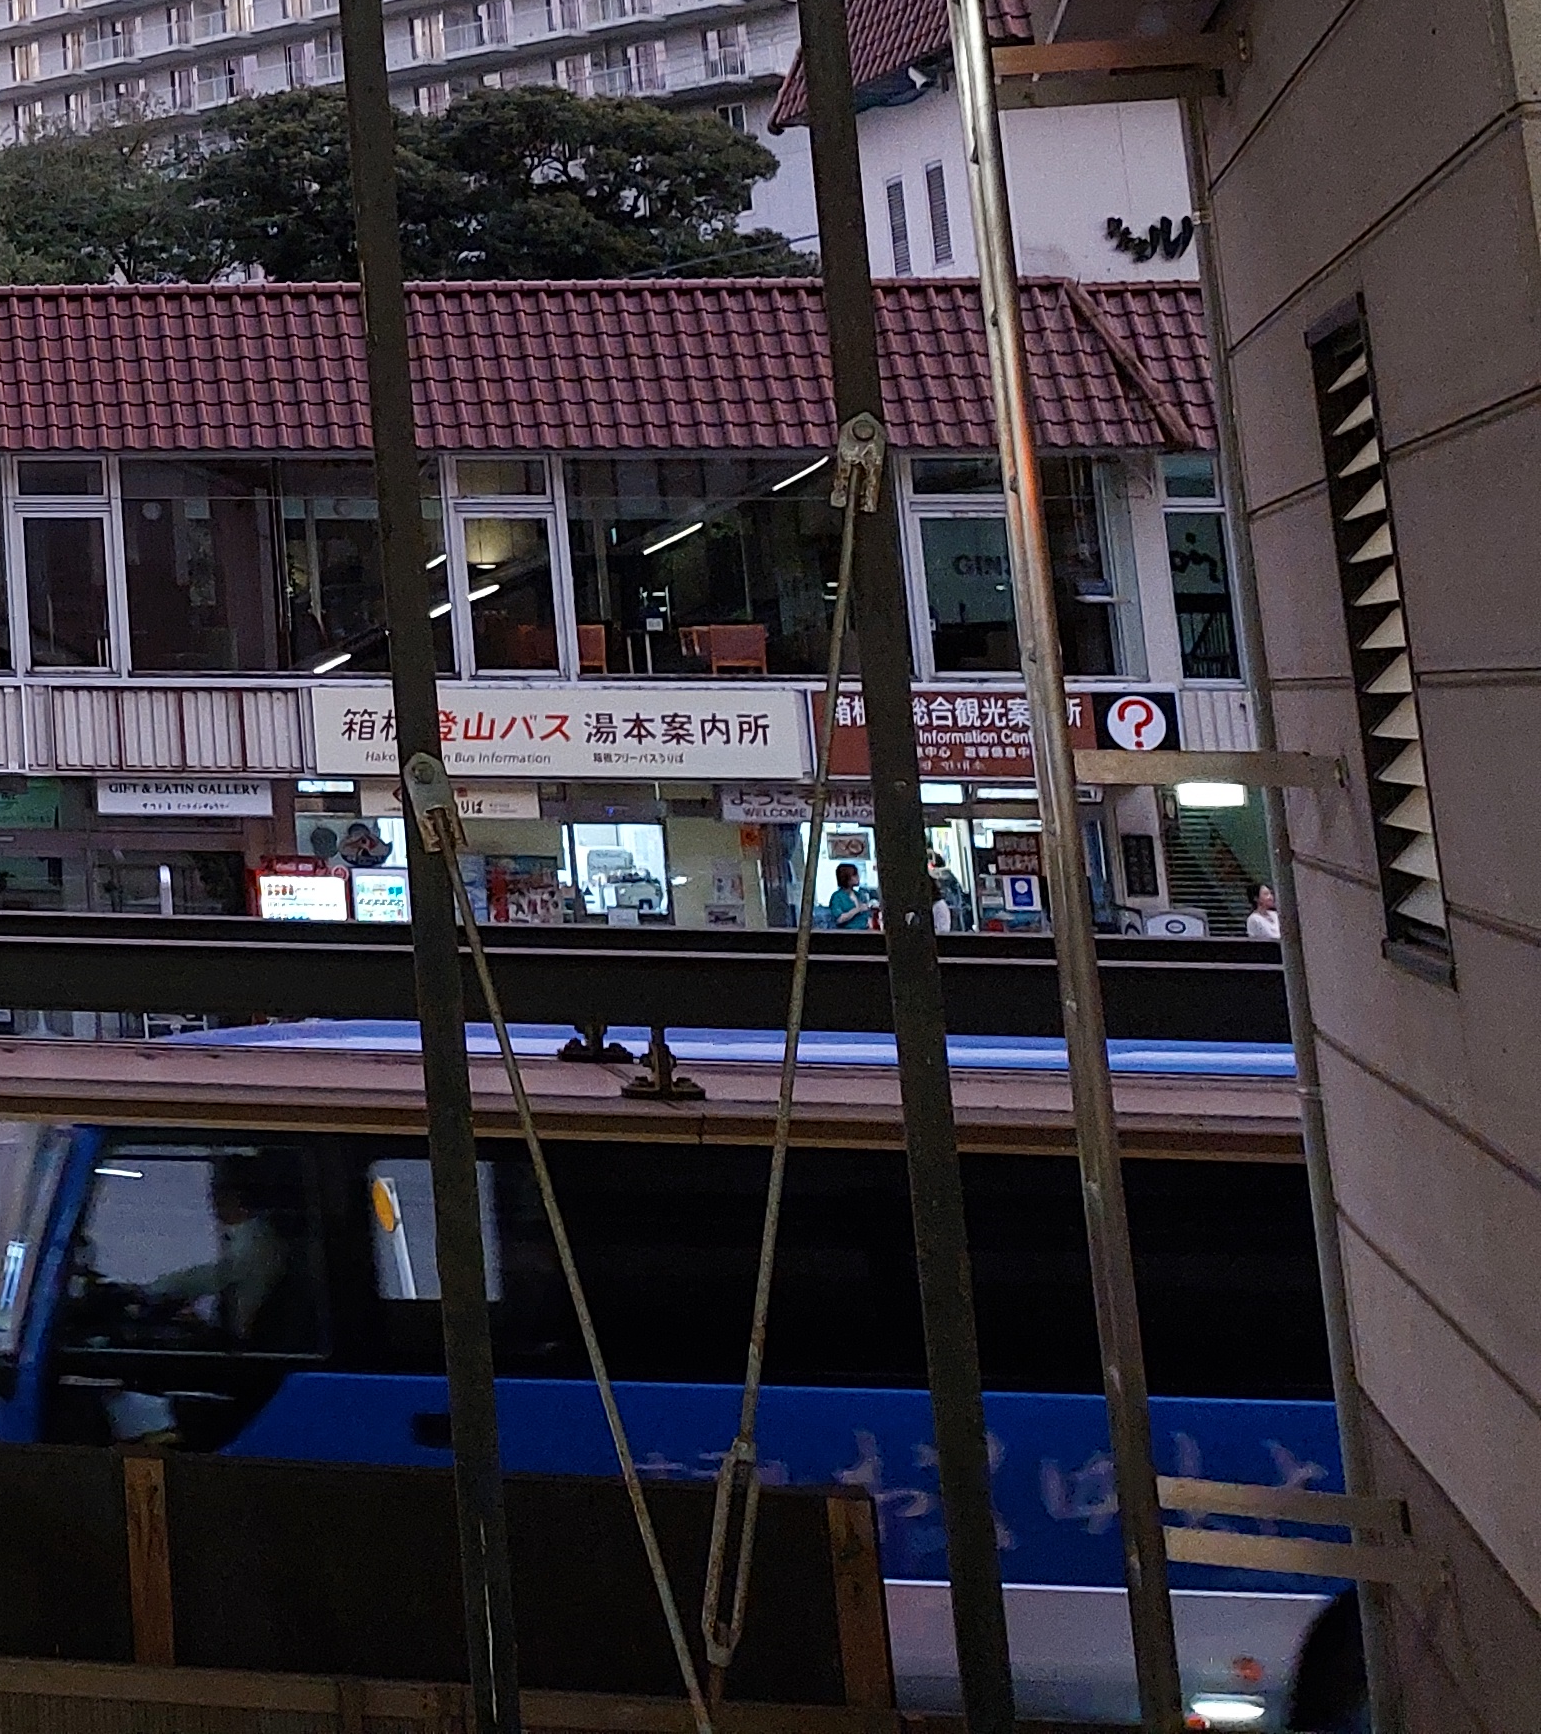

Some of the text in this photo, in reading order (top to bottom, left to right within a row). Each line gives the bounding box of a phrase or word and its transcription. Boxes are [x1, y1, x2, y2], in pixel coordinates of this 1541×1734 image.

[583, 712, 770, 746] 湯本案内所
[919, 729, 998, 745] Information
[366, 751, 396, 764] Hako
[454, 751, 475, 763] Bus
[478, 751, 551, 765] Information
[108, 783, 138, 794] GIFT
[141, 783, 151, 794] &
[198, 784, 260, 795] GALLERY
[460, 799, 484, 815] りば
[834, 808, 873, 819] HAKO
